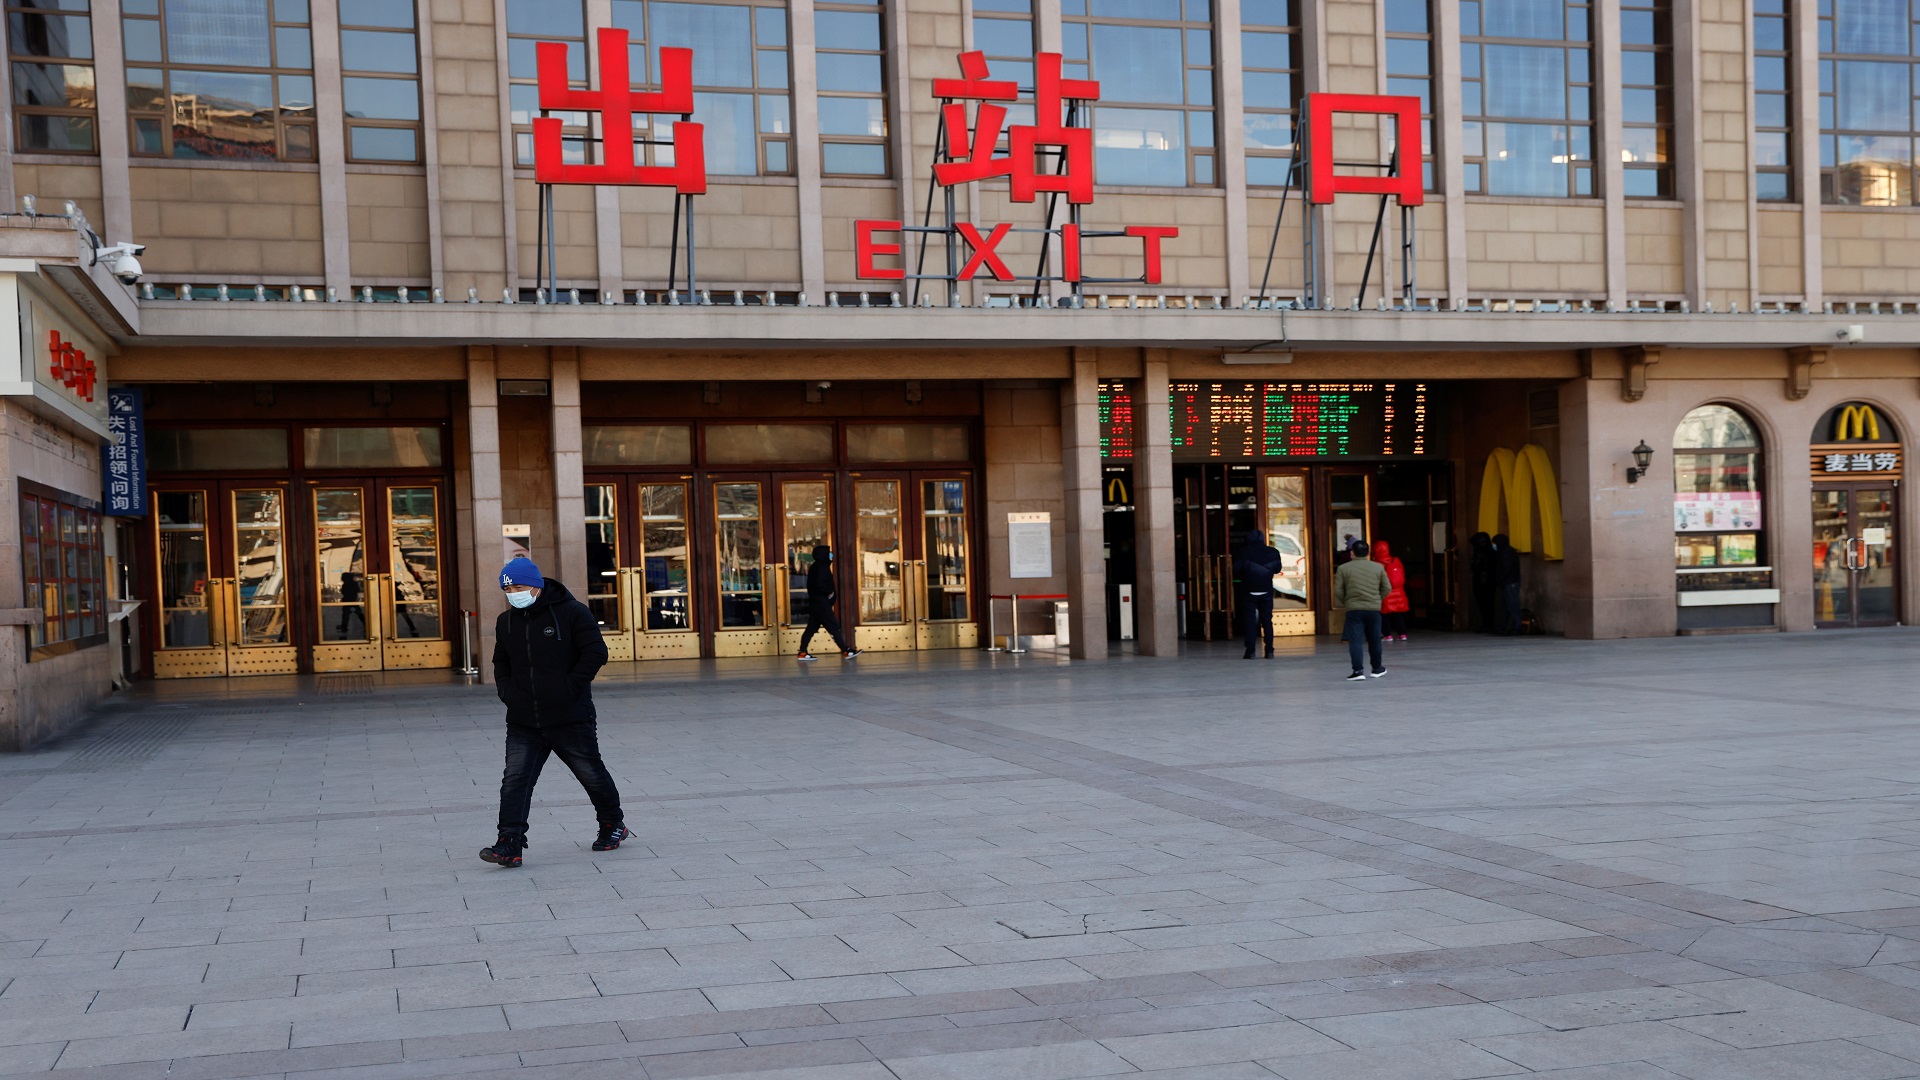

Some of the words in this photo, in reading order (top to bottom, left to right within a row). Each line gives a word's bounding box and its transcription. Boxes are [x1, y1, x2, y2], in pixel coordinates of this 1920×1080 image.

[533, 27, 1424, 207] 出站口
[855, 219, 1179, 284] EXIT
[1825, 452, 1897, 472] 麦当劳
[503, 575, 512, 585] LA
